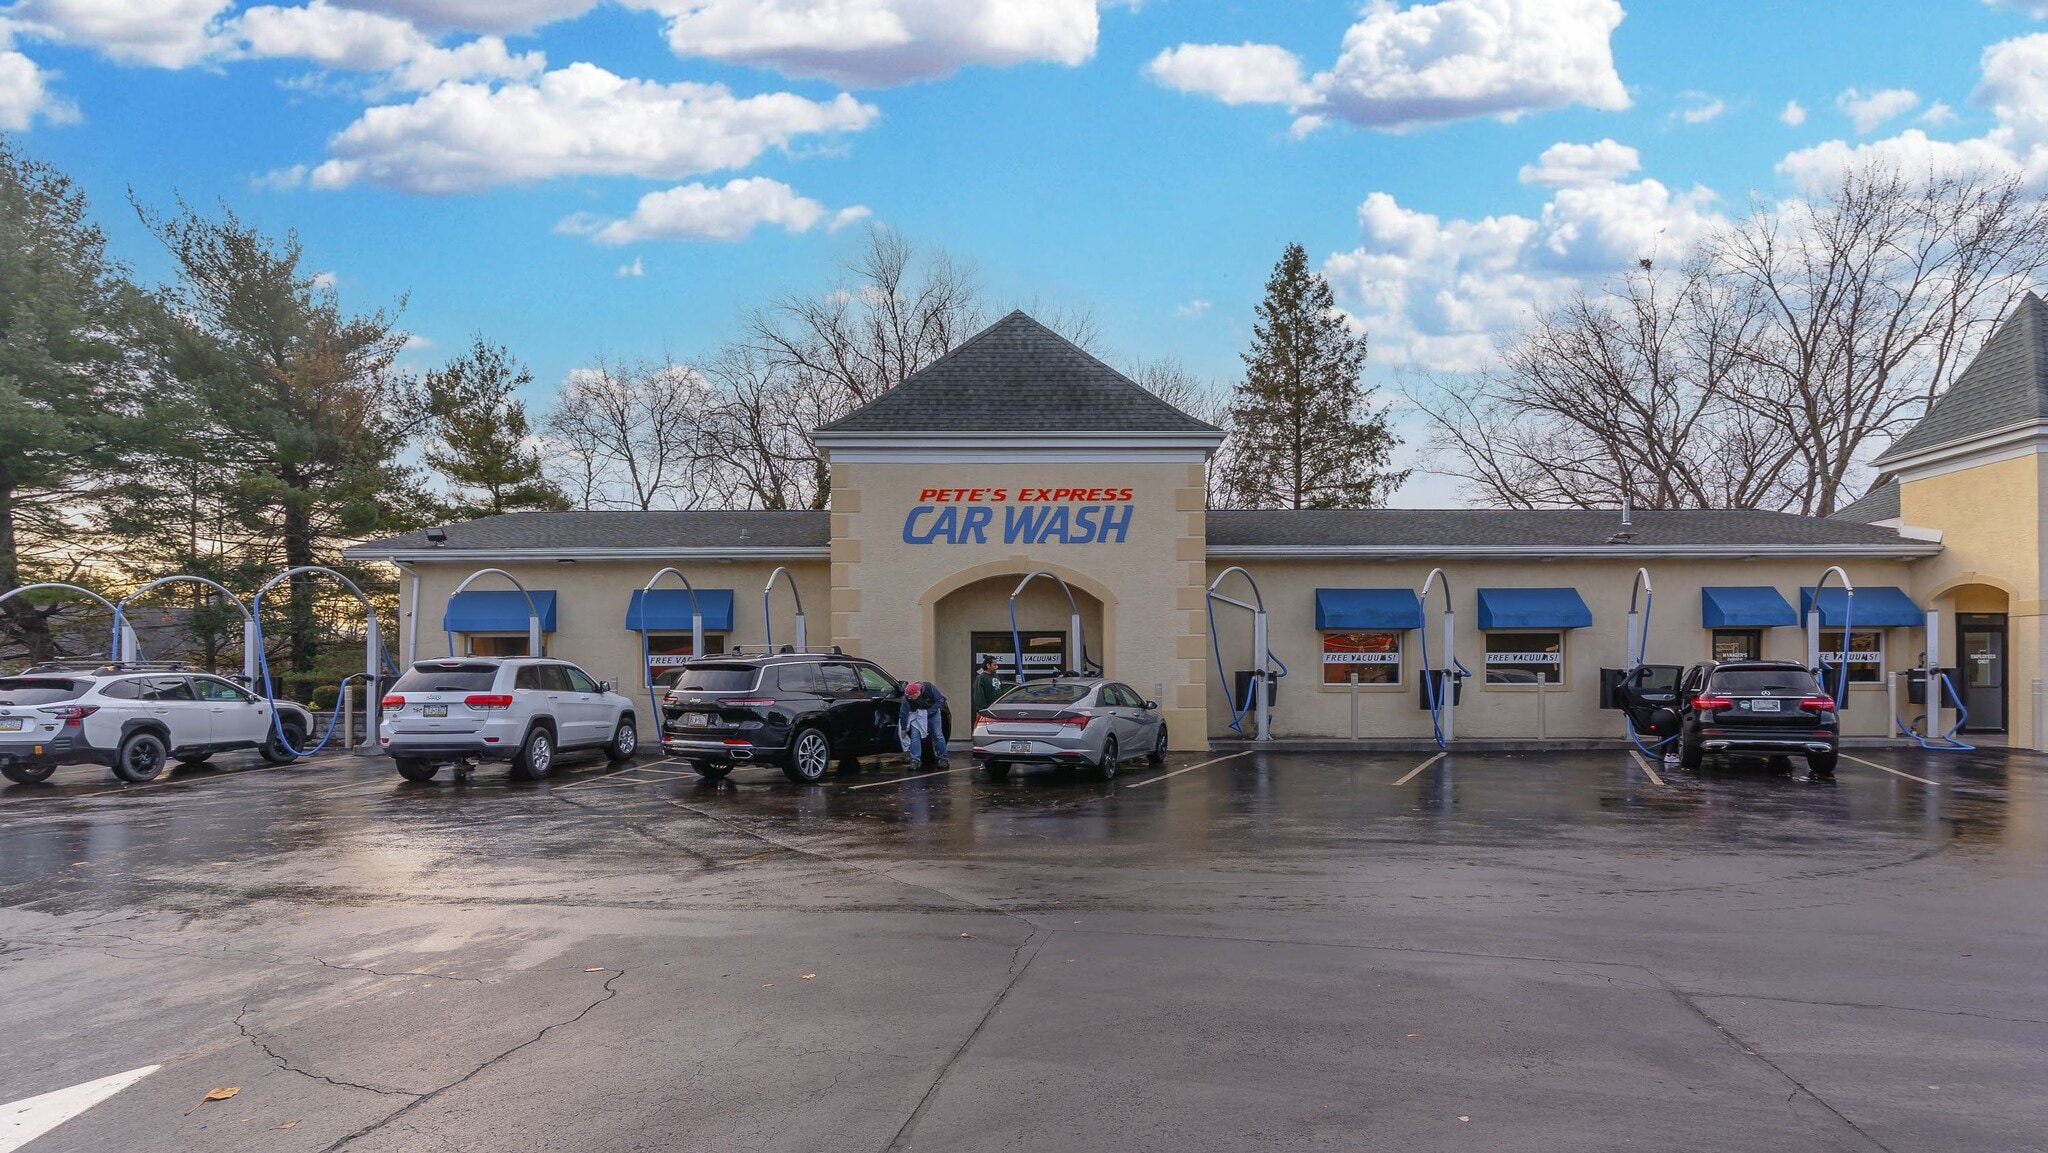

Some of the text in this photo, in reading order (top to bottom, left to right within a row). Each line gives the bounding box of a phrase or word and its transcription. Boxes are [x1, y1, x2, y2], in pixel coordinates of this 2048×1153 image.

[919, 488, 1134, 502] PETE'S EXPRESS
[902, 505, 1134, 544] CAR WASH
[650, 656, 673, 664] FREE
